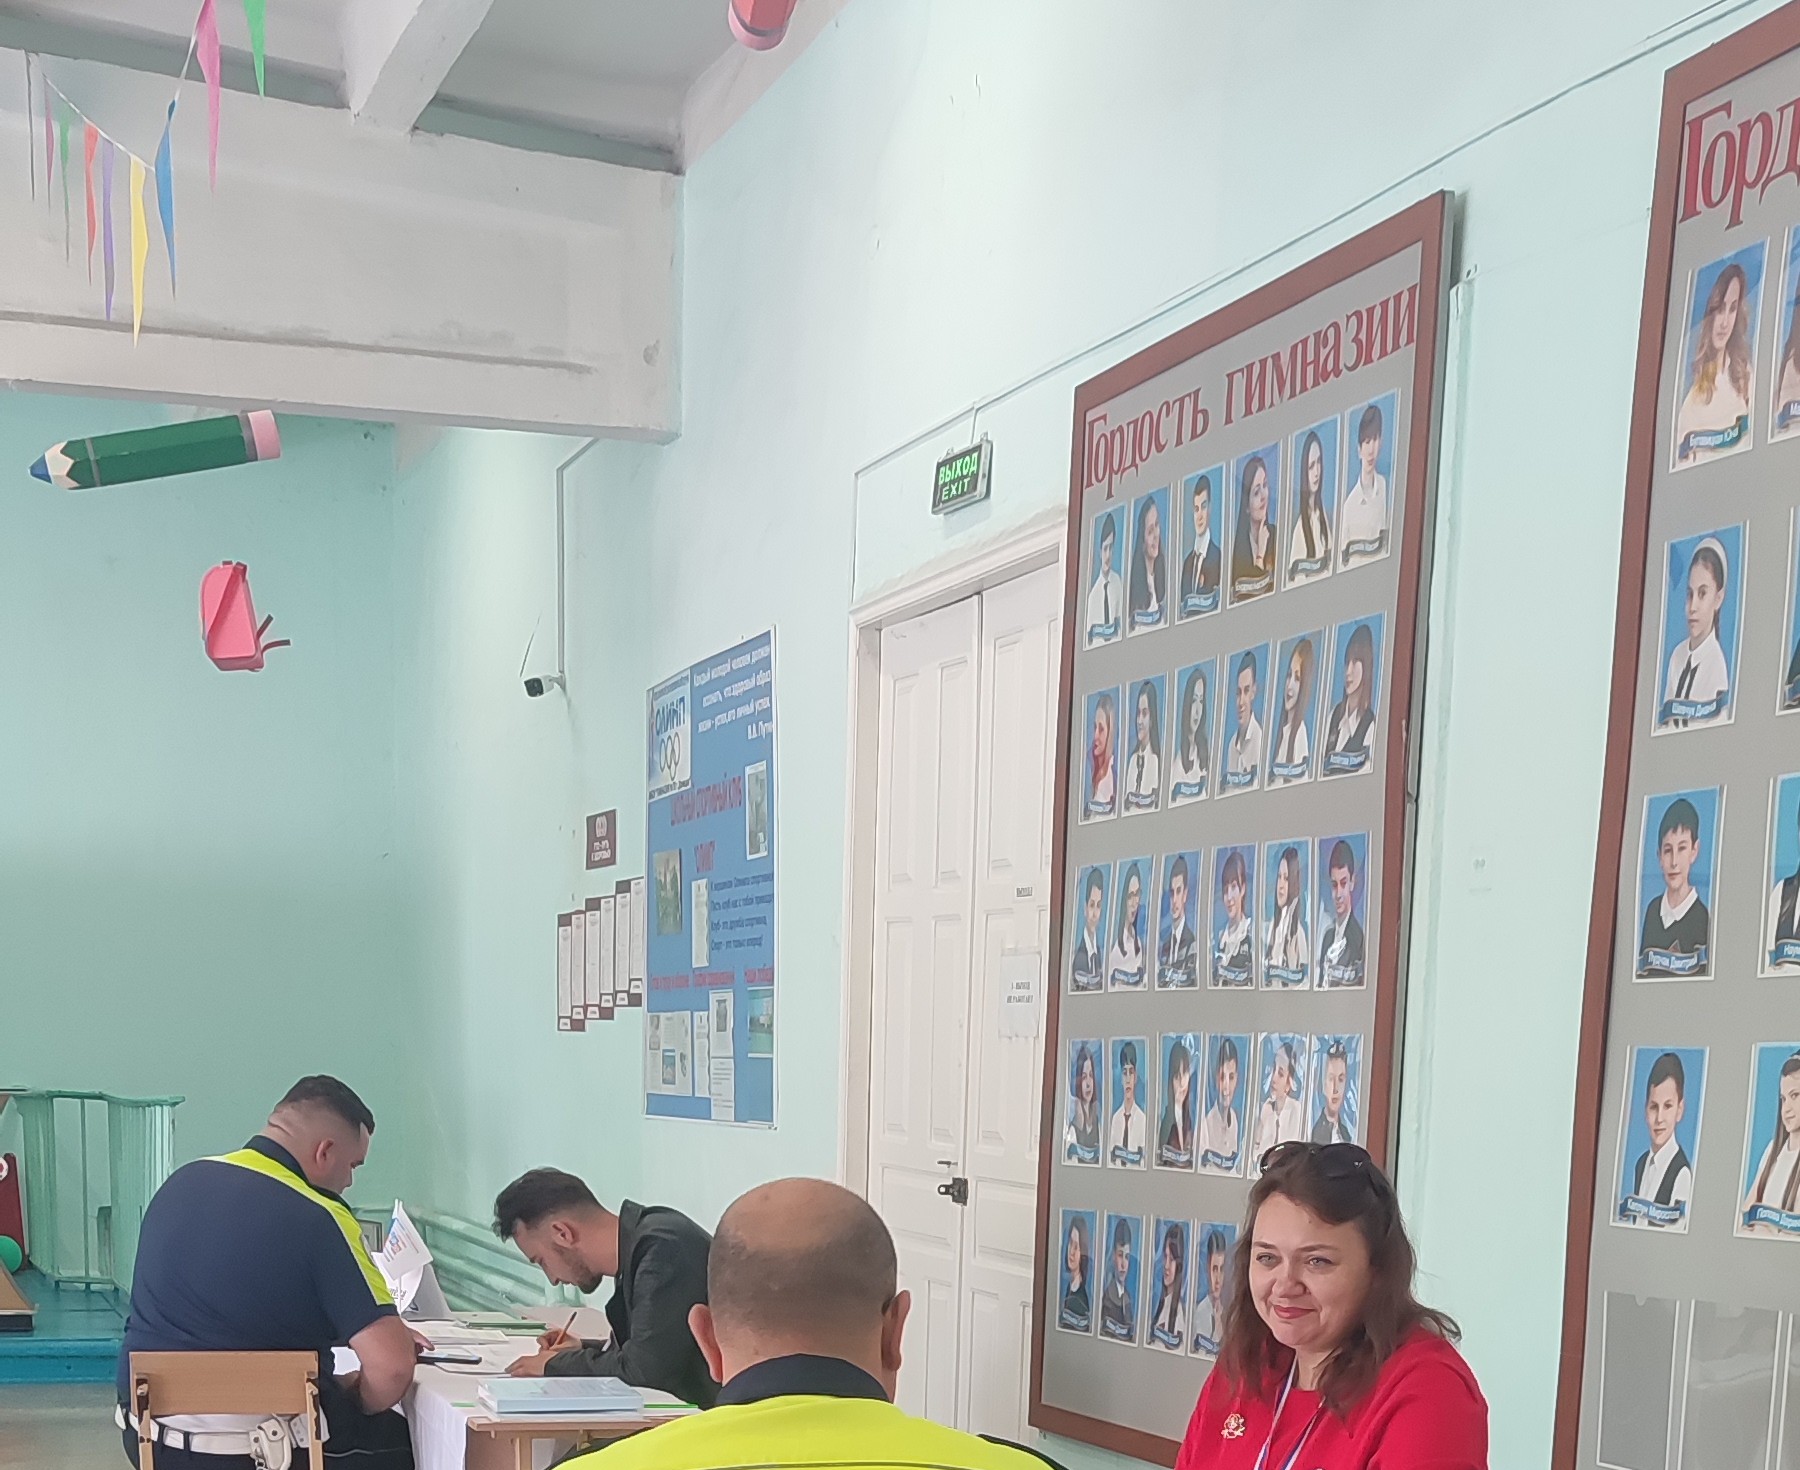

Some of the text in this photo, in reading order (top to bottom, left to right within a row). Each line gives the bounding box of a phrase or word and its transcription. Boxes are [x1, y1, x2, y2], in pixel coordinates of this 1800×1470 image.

[1084, 282, 1419, 501] Гордость гимназии
[938, 451, 979, 485] ВЫХОД
[942, 477, 970, 501] EXIT
[656, 695, 685, 736] ОЛИМП
